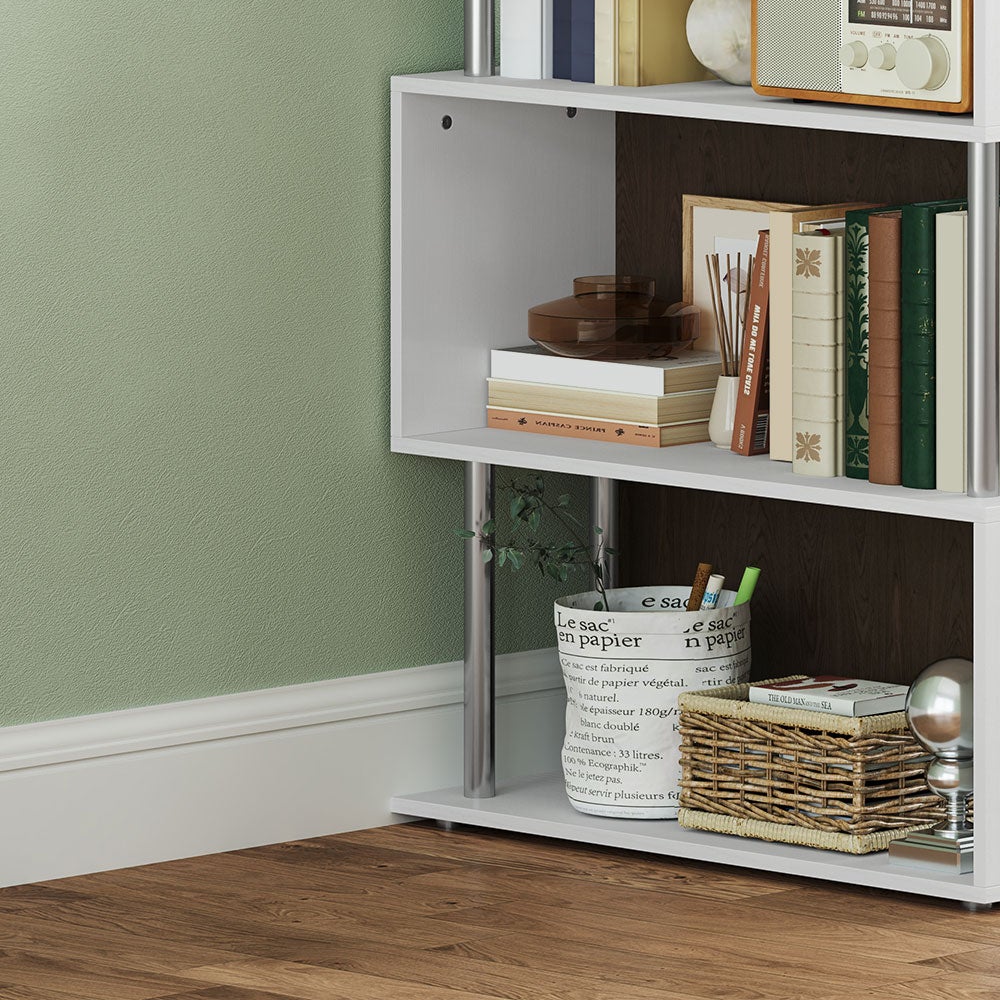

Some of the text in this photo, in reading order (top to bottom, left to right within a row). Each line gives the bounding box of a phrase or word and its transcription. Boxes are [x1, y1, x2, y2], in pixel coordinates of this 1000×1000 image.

[557, 611, 576, 629] Le
[683, 621, 704, 634] e
[559, 631, 642, 652] en papier
[705, 627, 746, 651] papier
[561, 658, 649, 675] Ce sac est fabriqué
[719, 663, 733, 671] est
[588, 677, 600, 686] de
[601, 678, 639, 689] papier
[642, 678, 688, 690] végétal.
[583, 693, 620, 703] naturel.
[768, 693, 780, 703] THE
[780, 695, 793, 704] OLD
[793, 696, 806, 706] MAN
[821, 702, 832, 711] SEA
[589, 704, 635, 716] épaisseur
[580, 717, 640, 732] blanc doublé
[573, 730, 590, 741] kraft
[591, 732, 615, 744] brun
[564, 755, 577, 765] 100
[577, 758, 587, 766] %
[618, 750, 631, 760] 33
[632, 750, 664, 760] litres.
[564, 767, 623, 786] Ne le jetez pas.
[588, 787, 613, 799] servir
[613, 789, 665, 801] plusieurs
